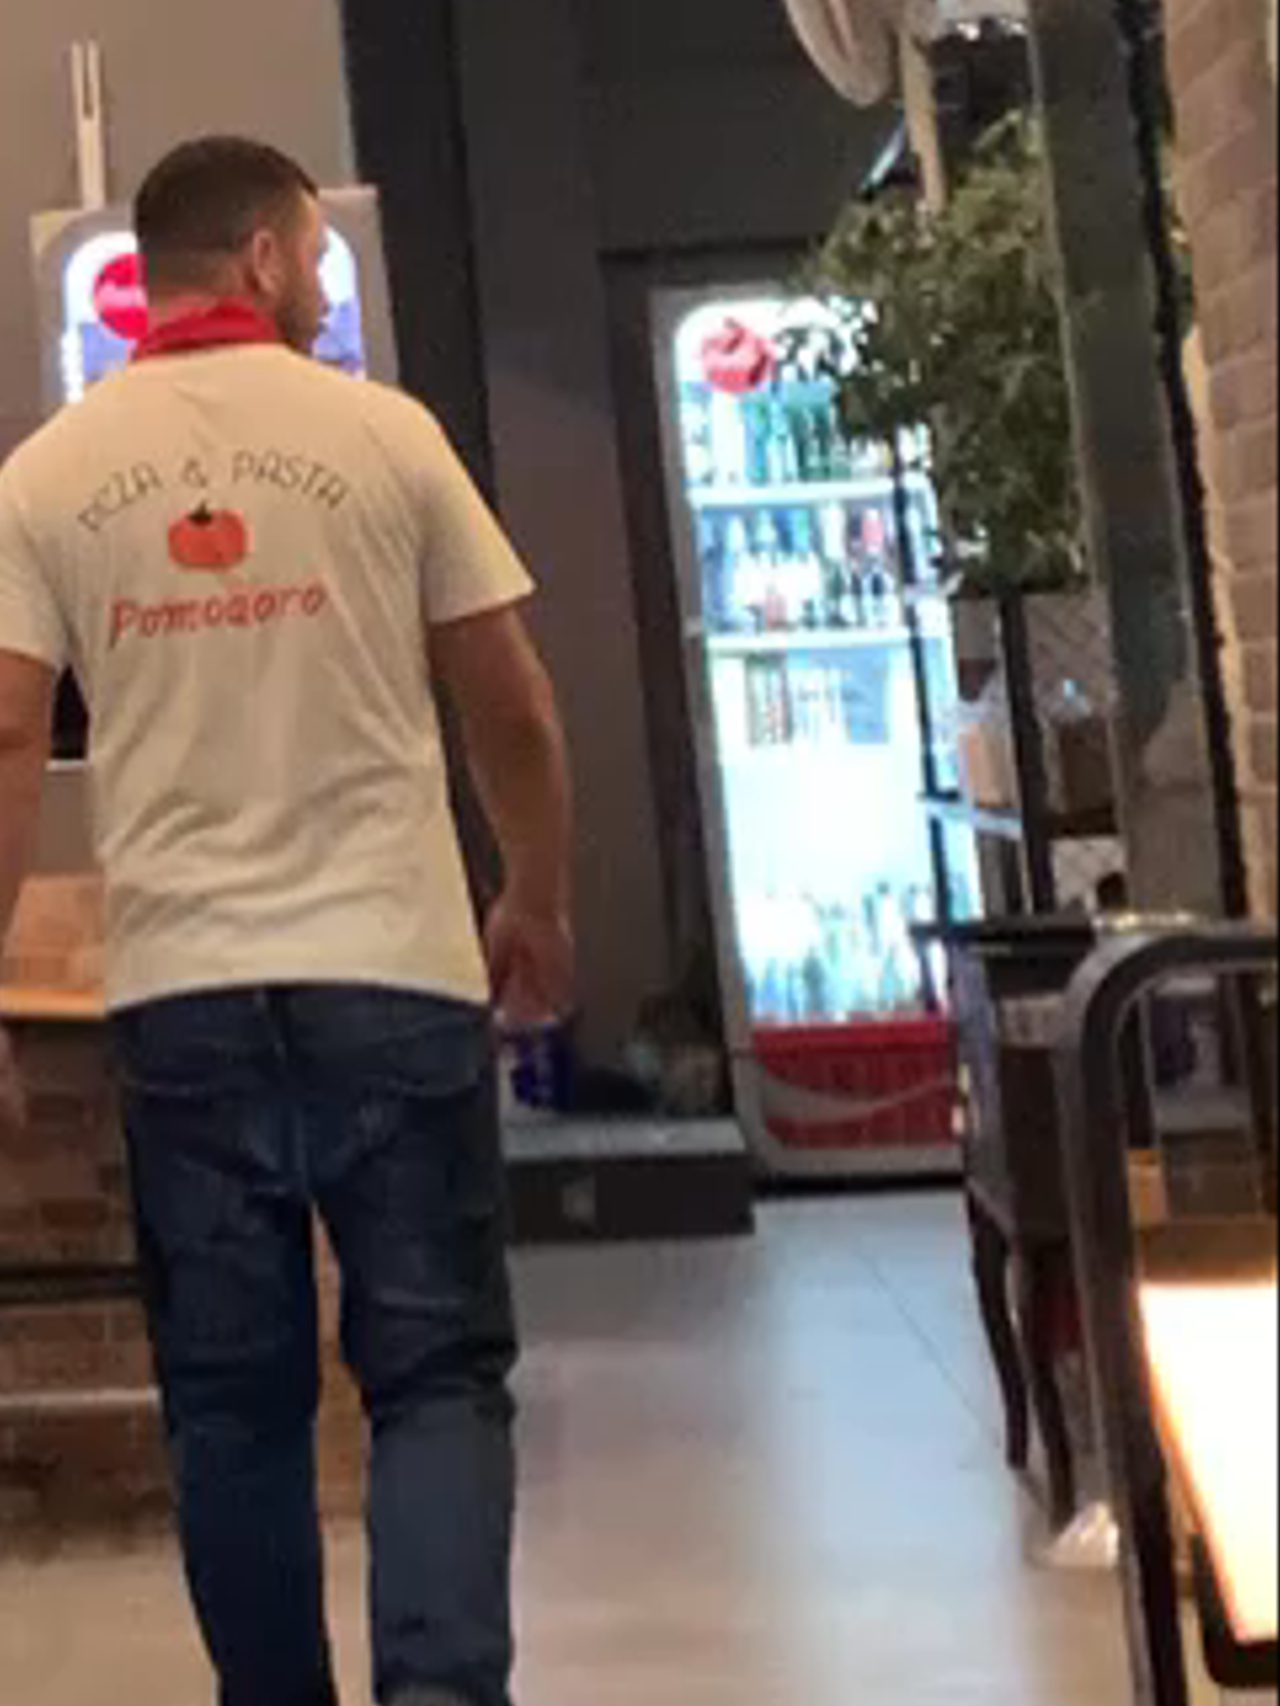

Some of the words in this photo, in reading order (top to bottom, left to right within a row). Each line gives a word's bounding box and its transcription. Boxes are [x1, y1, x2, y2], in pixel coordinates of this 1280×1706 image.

[182, 458, 208, 488] &
[231, 450, 347, 509] PASTA
[107, 584, 327, 649] Pomodoro
